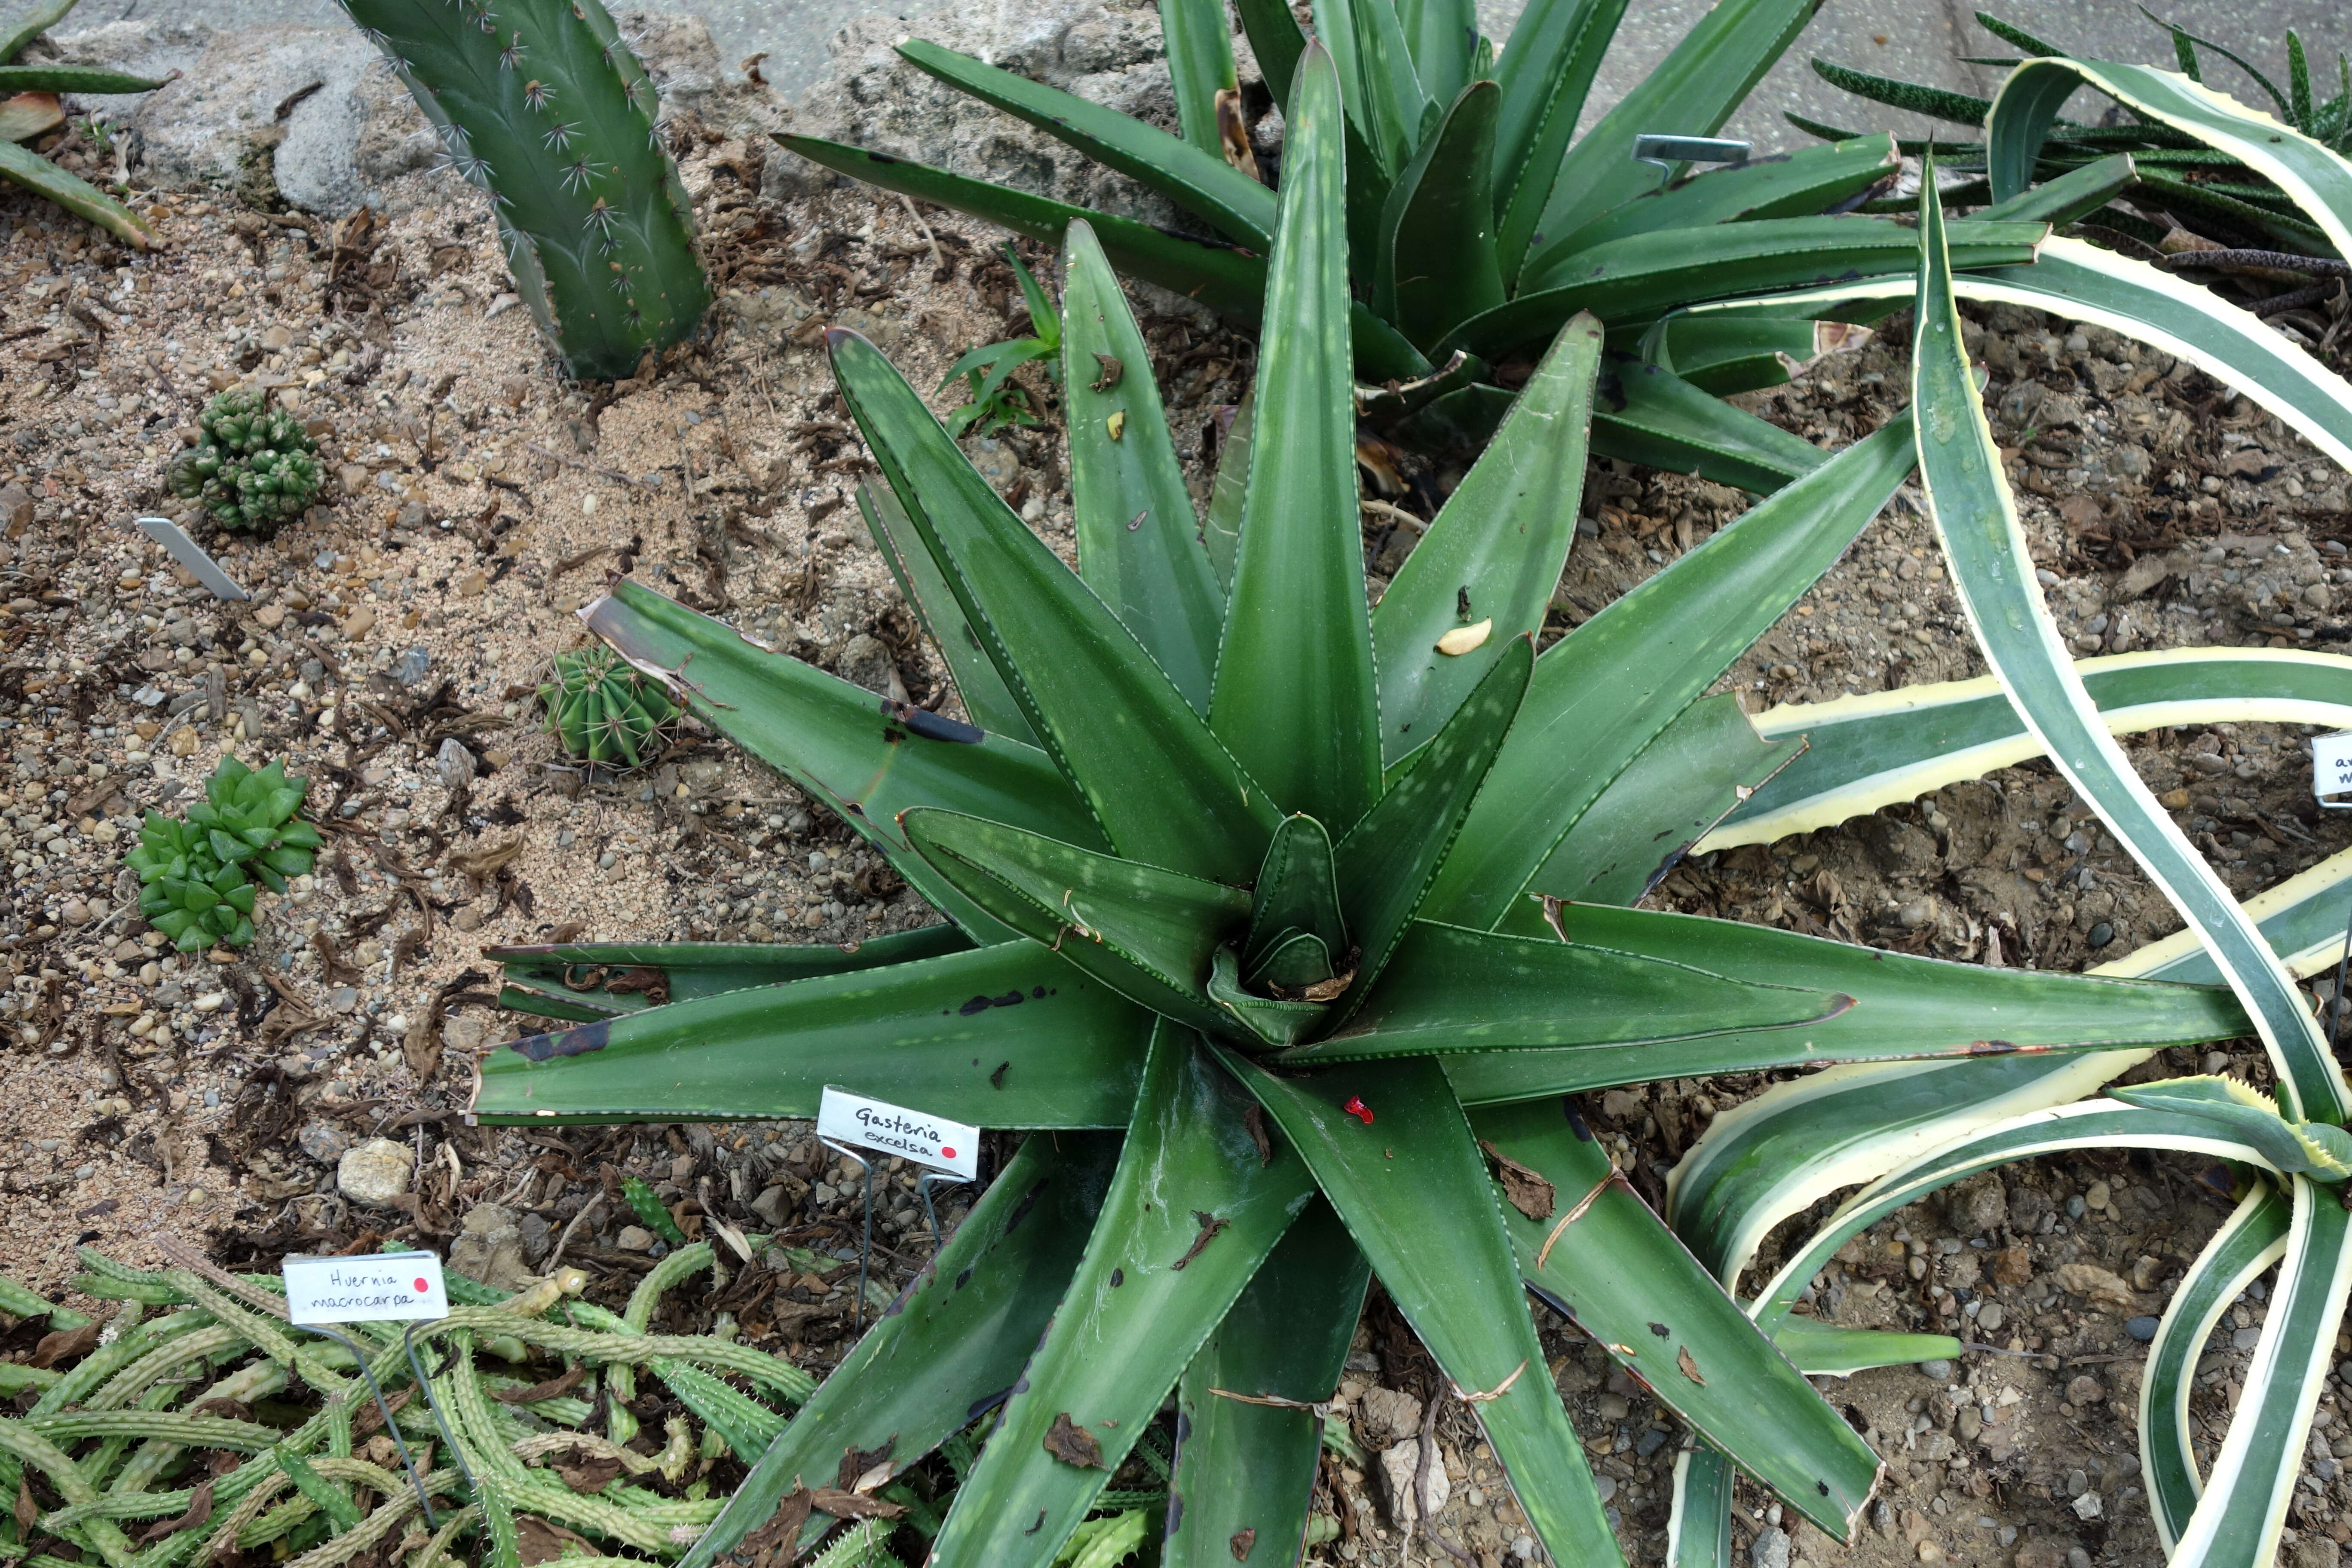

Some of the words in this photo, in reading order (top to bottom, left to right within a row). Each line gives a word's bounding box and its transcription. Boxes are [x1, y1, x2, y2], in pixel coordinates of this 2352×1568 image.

[855, 1108, 941, 1142] Gasteria
[864, 1131, 933, 1157] excelsa
[311, 1295, 414, 1308] macrocarpa
